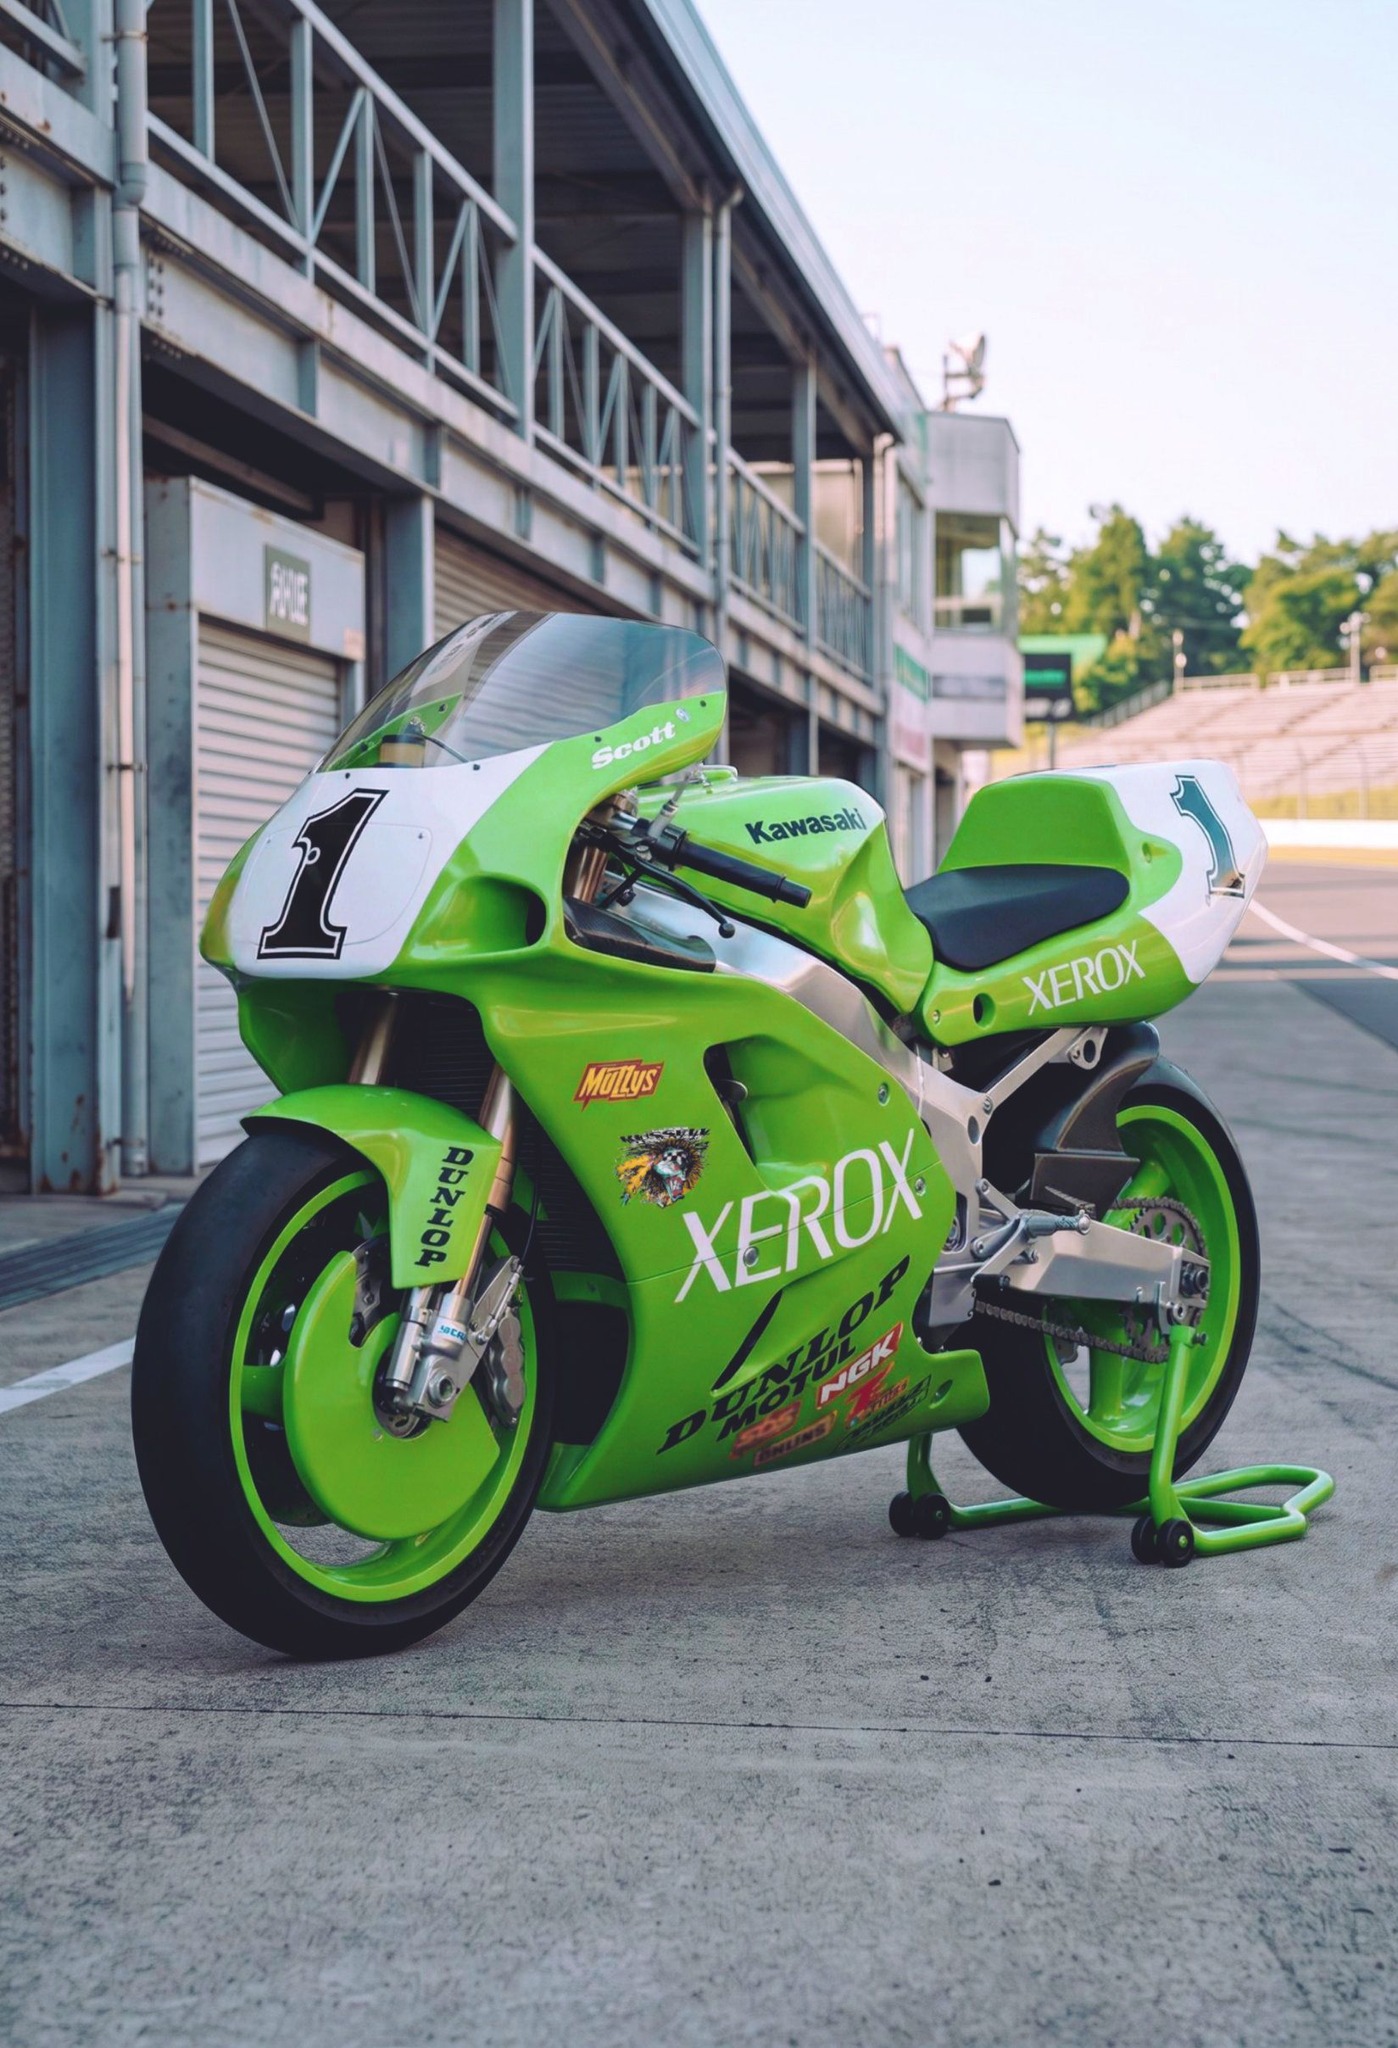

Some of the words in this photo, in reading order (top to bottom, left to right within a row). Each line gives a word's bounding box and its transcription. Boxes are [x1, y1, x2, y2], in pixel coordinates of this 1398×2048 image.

[592, 721, 676, 770] Scott
[256, 787, 391, 961] 1
[745, 807, 867, 845] Kawasaki
[1170, 774, 1246, 900] 1
[1022, 940, 1146, 1016] XEROX
[414, 1146, 475, 1268] DUNLOP
[674, 1127, 924, 1304] XEROX
[656, 1254, 911, 1456] DUNLOP
[716, 1336, 856, 1442] MOTUL
[820, 1330, 895, 1405] NGK
